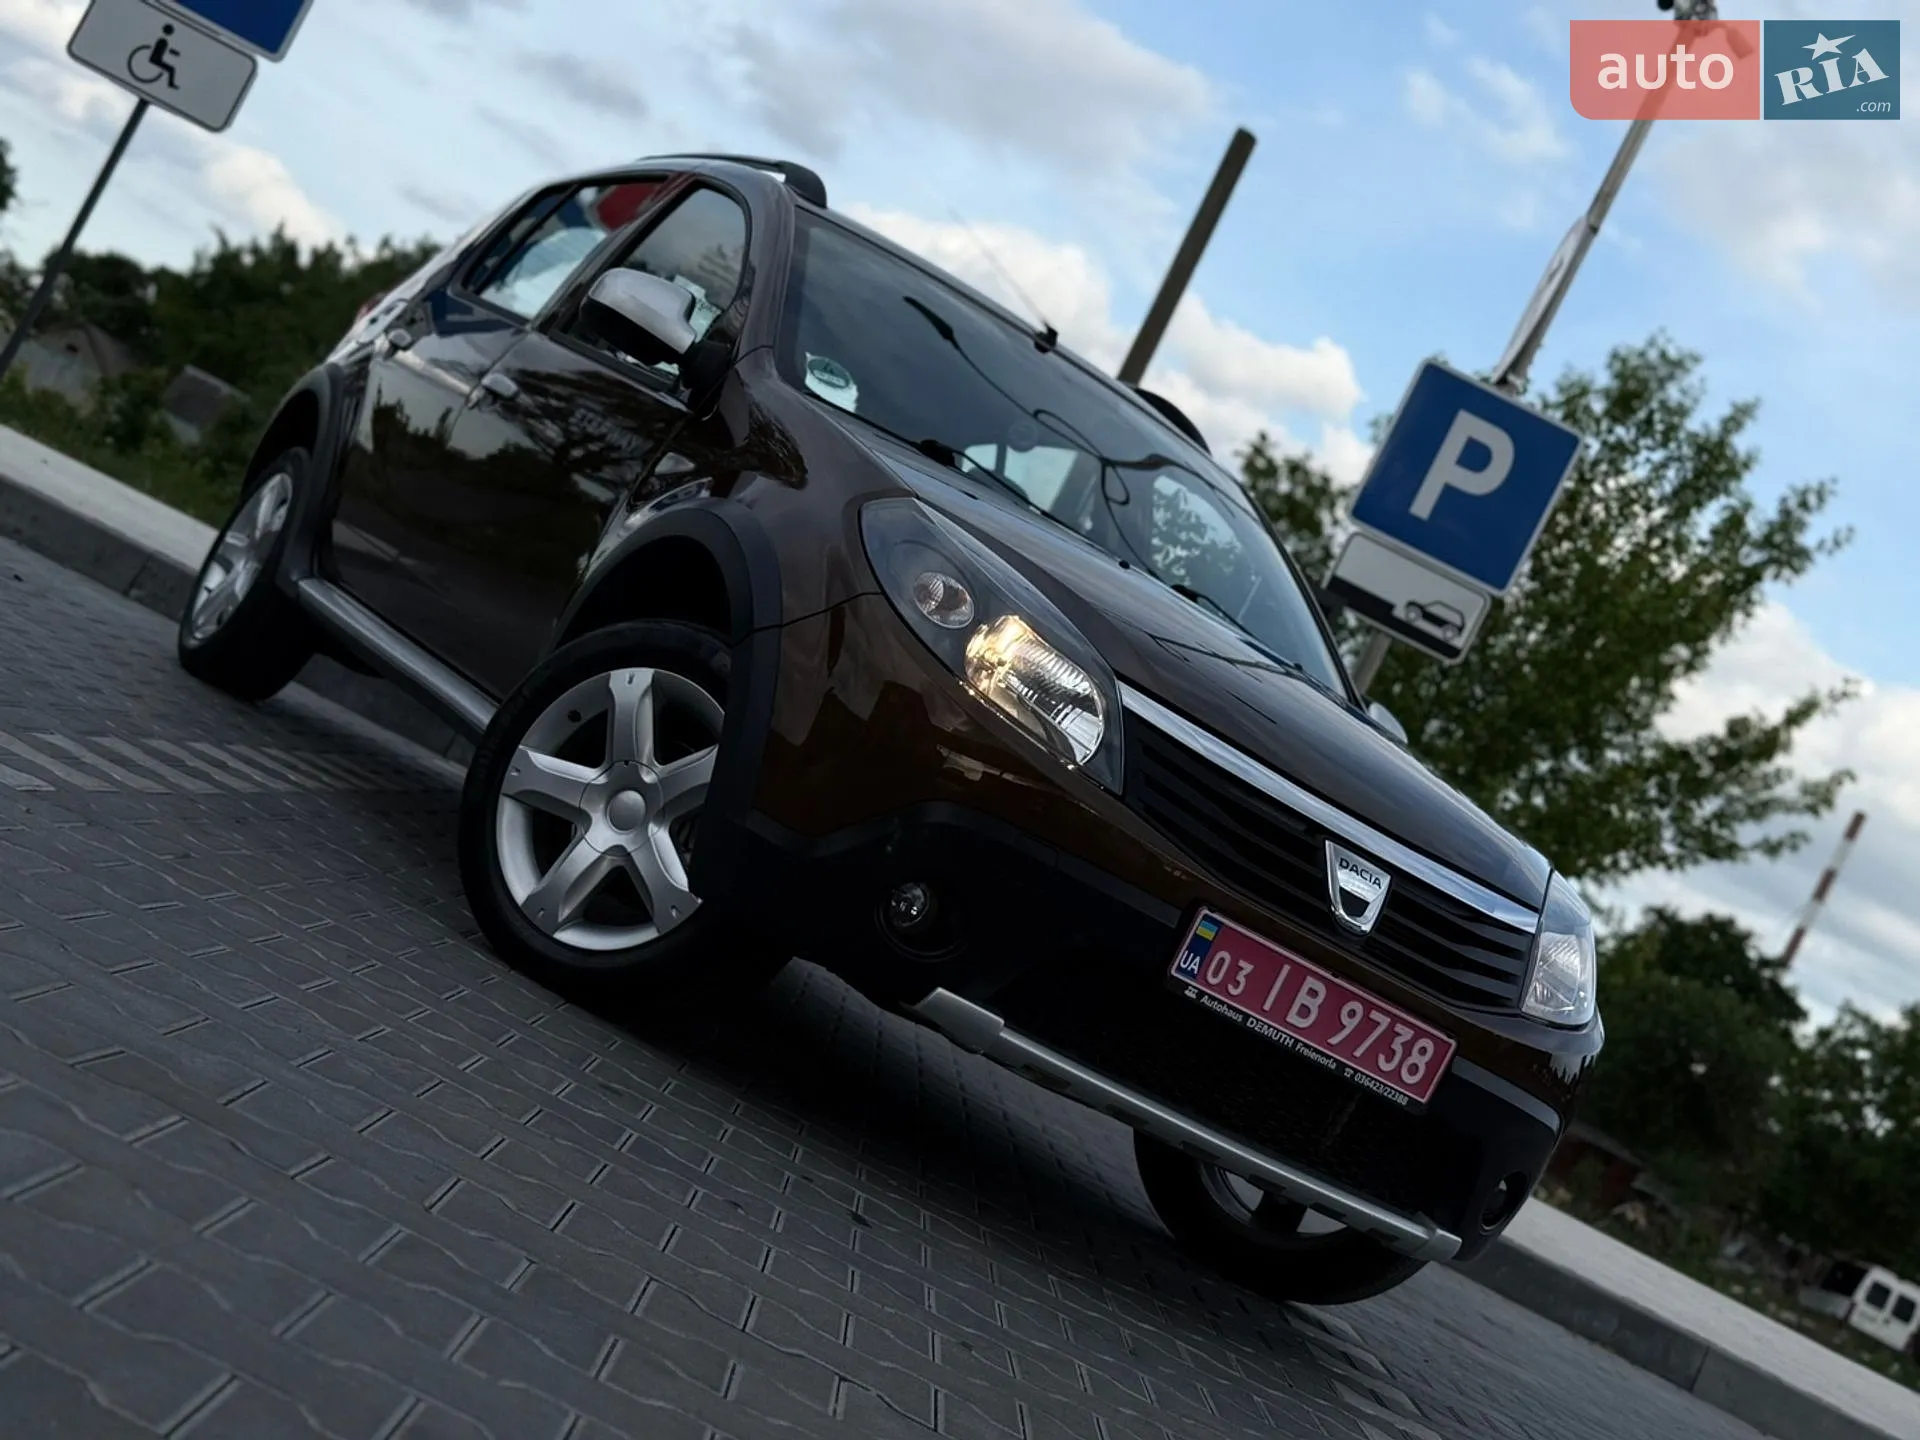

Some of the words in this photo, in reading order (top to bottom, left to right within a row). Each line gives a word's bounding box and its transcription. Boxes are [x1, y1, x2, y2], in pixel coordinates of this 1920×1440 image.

[1409, 408, 1515, 522] P
[1339, 857, 1382, 889] DACIA
[1180, 950, 1200, 974] UA
[1200, 995, 1243, 1022] Autohaus
[1246, 1017, 1295, 1048] DEMUTH
[1206, 951, 1254, 996] 03
[1327, 1001, 1435, 1085] 9738
